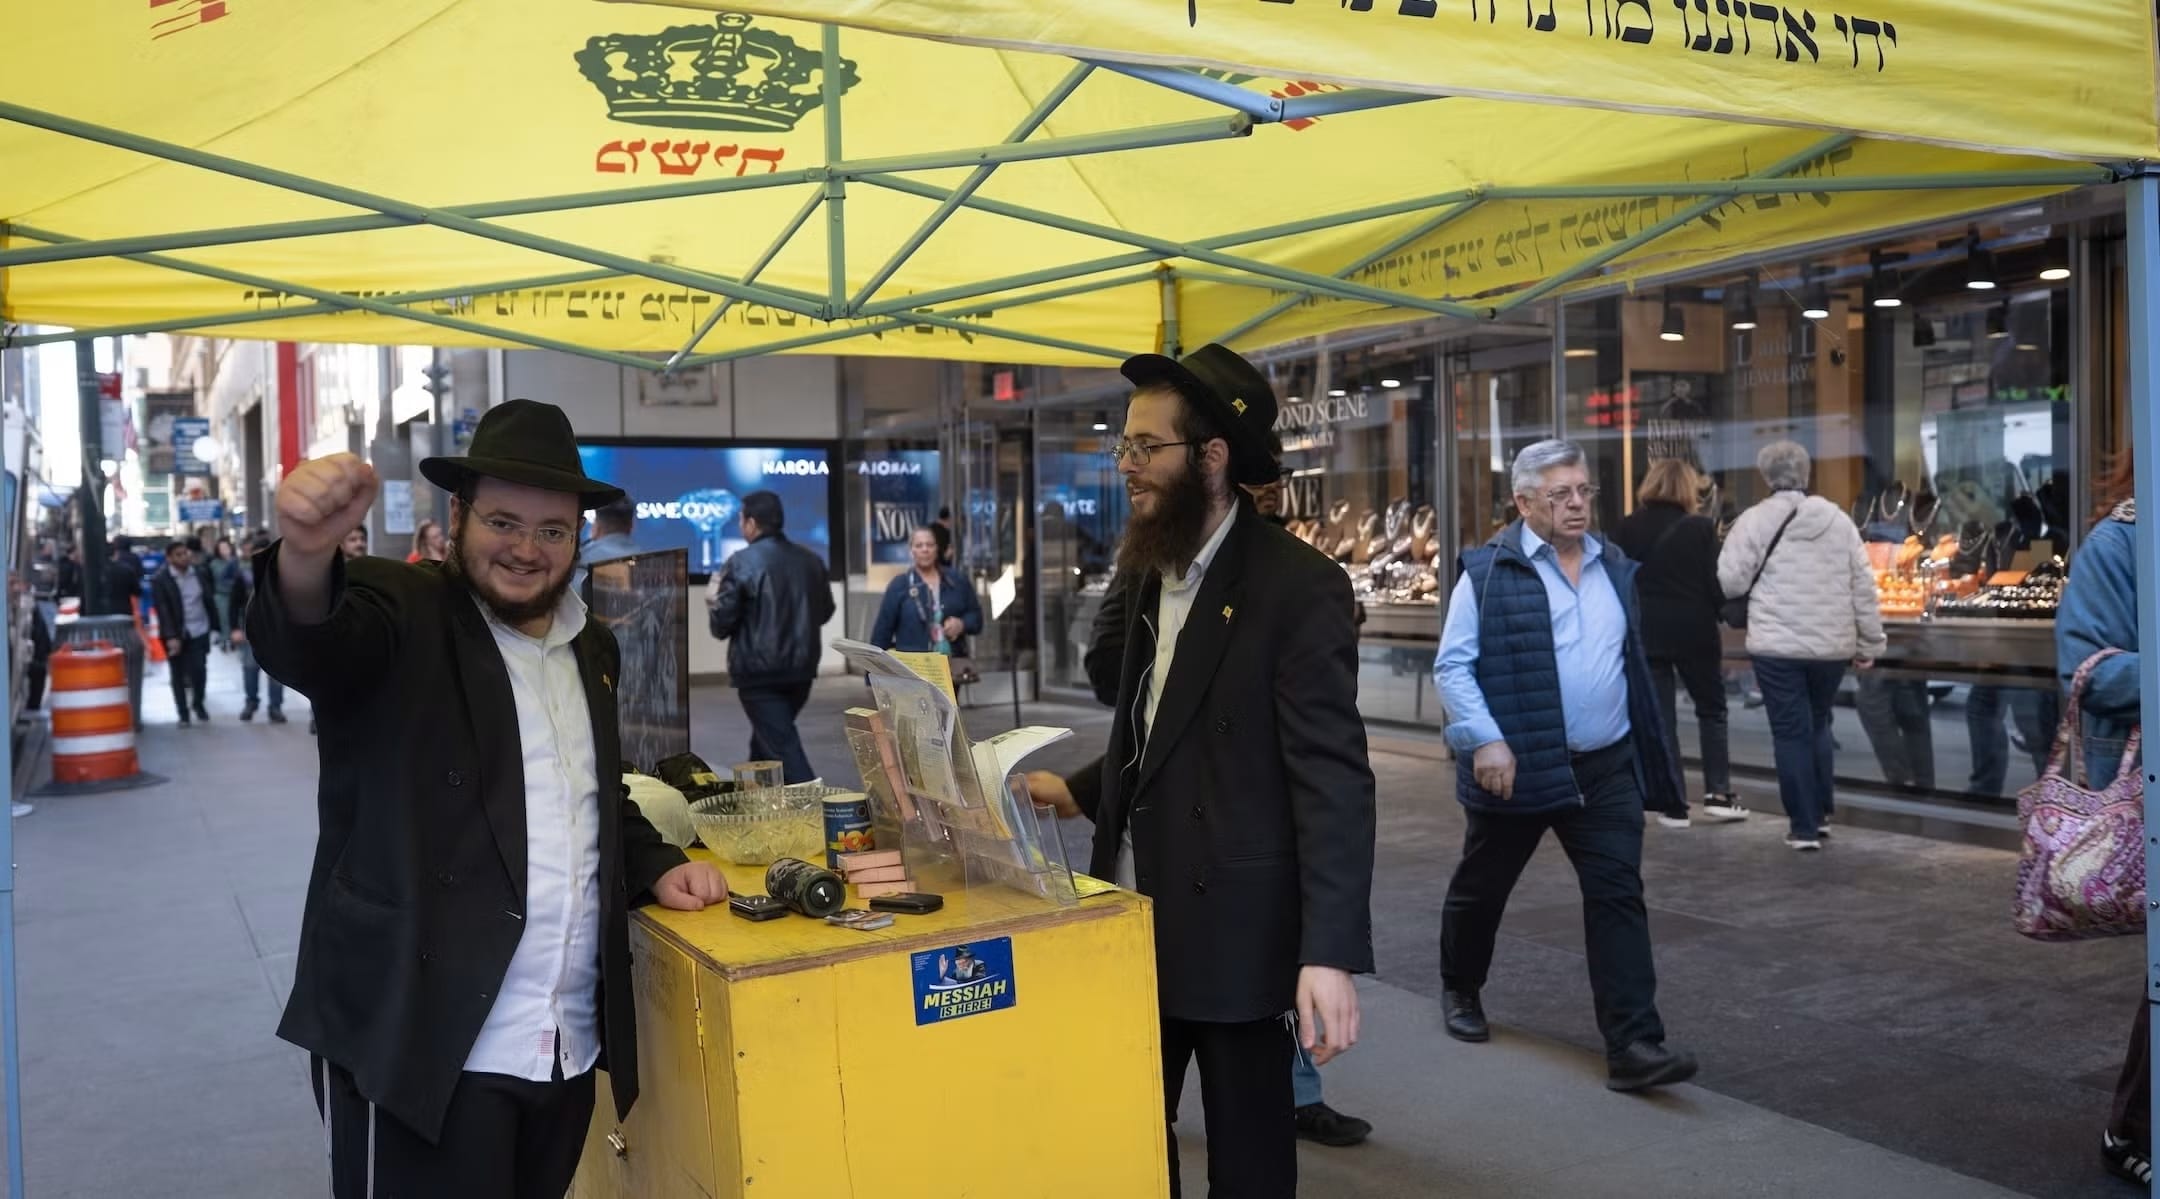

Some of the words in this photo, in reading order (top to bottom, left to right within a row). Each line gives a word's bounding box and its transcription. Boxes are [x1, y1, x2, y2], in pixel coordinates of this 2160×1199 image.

[1673, 0, 1819, 63] אדוננו
[1833, 12, 1898, 72] יחי
[1316, 393, 1368, 424] SCENE
[763, 459, 829, 476] NAROLA
[636, 501, 681, 520] SAME
[923, 979, 1007, 1010] MESSIAH
[941, 1006, 953, 1018] IS
[955, 998, 991, 1014] HERE!
